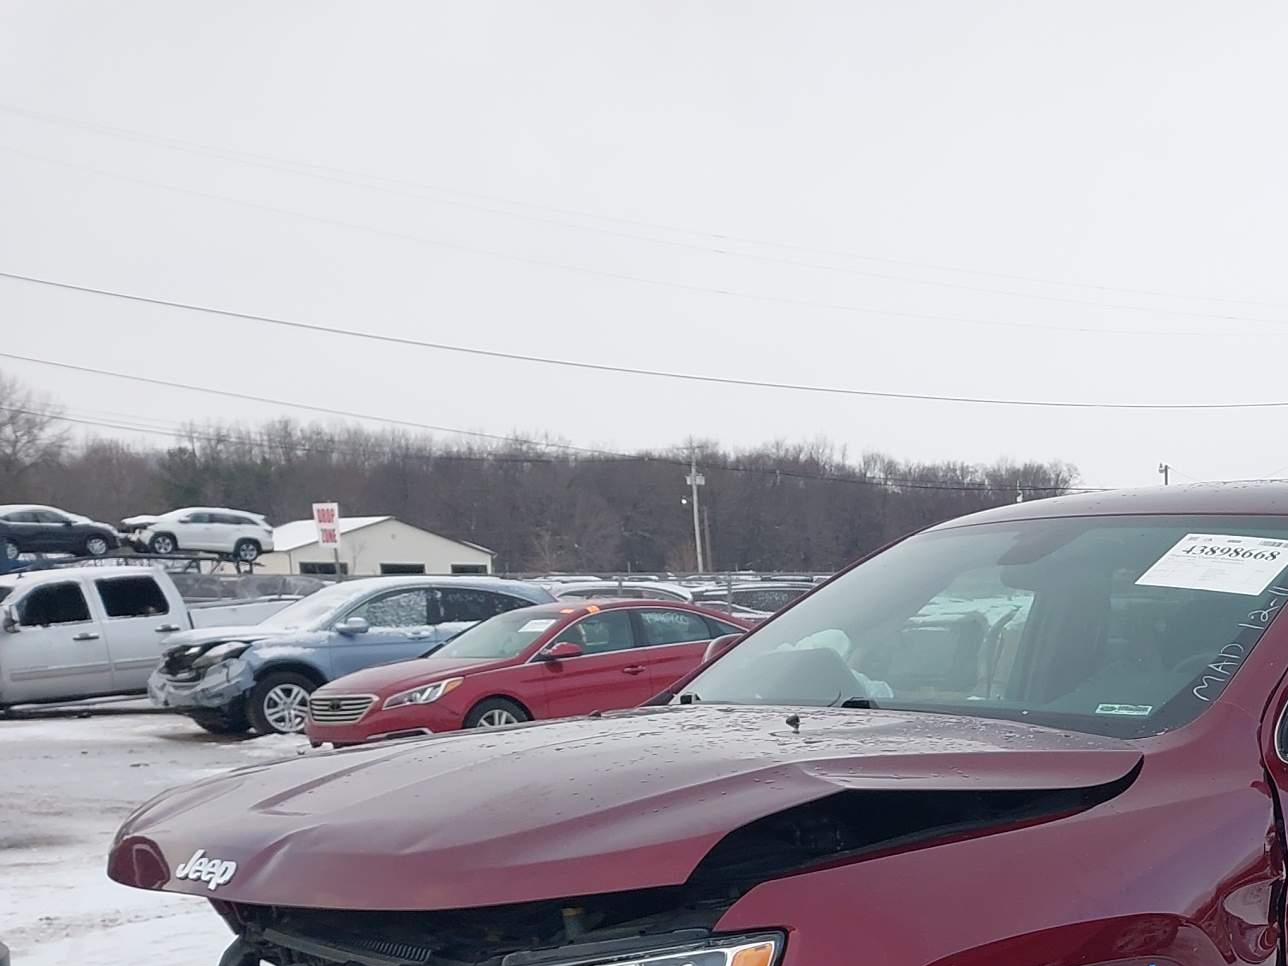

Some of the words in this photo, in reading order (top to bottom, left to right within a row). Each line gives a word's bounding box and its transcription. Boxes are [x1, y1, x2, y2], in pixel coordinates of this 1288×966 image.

[317, 508, 336, 523] DROP
[1182, 544, 1281, 562] 43898668
[1192, 643, 1244, 701] MAD
[175, 848, 238, 891] Jeep
